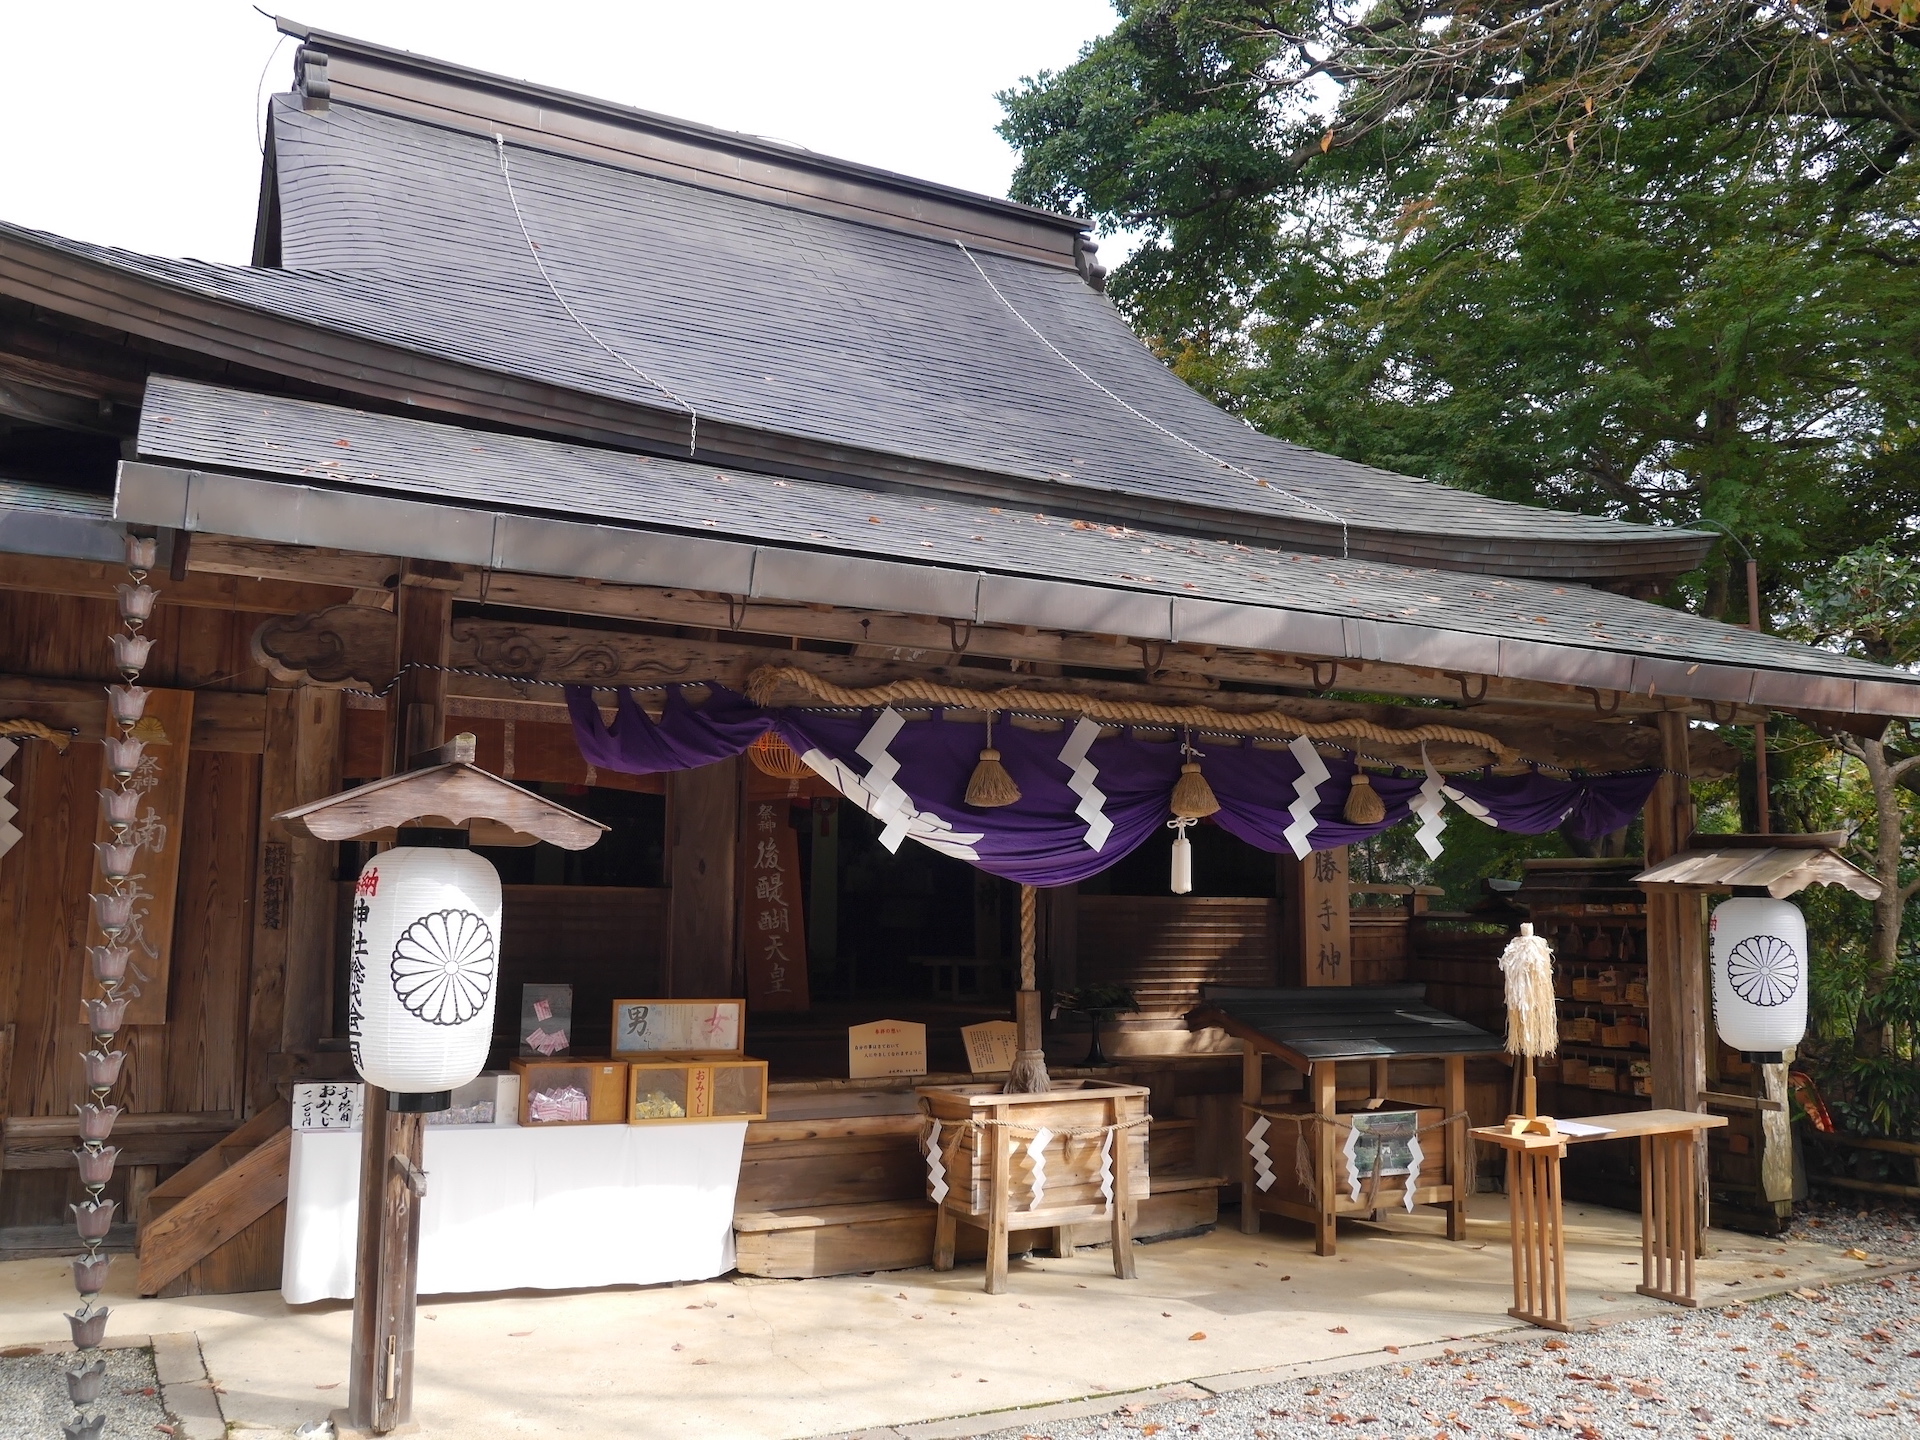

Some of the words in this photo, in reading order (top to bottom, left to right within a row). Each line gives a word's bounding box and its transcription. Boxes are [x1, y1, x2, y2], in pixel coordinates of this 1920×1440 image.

[132, 753, 162, 793] 祭神
[756, 803, 777, 833] 祭神
[753, 836, 793, 995] 後醍醐天皇
[1312, 850, 1342, 981] 勝手神
[316, 1084, 337, 1127] おみくじ
[694, 1069, 705, 1115] おみくじ
